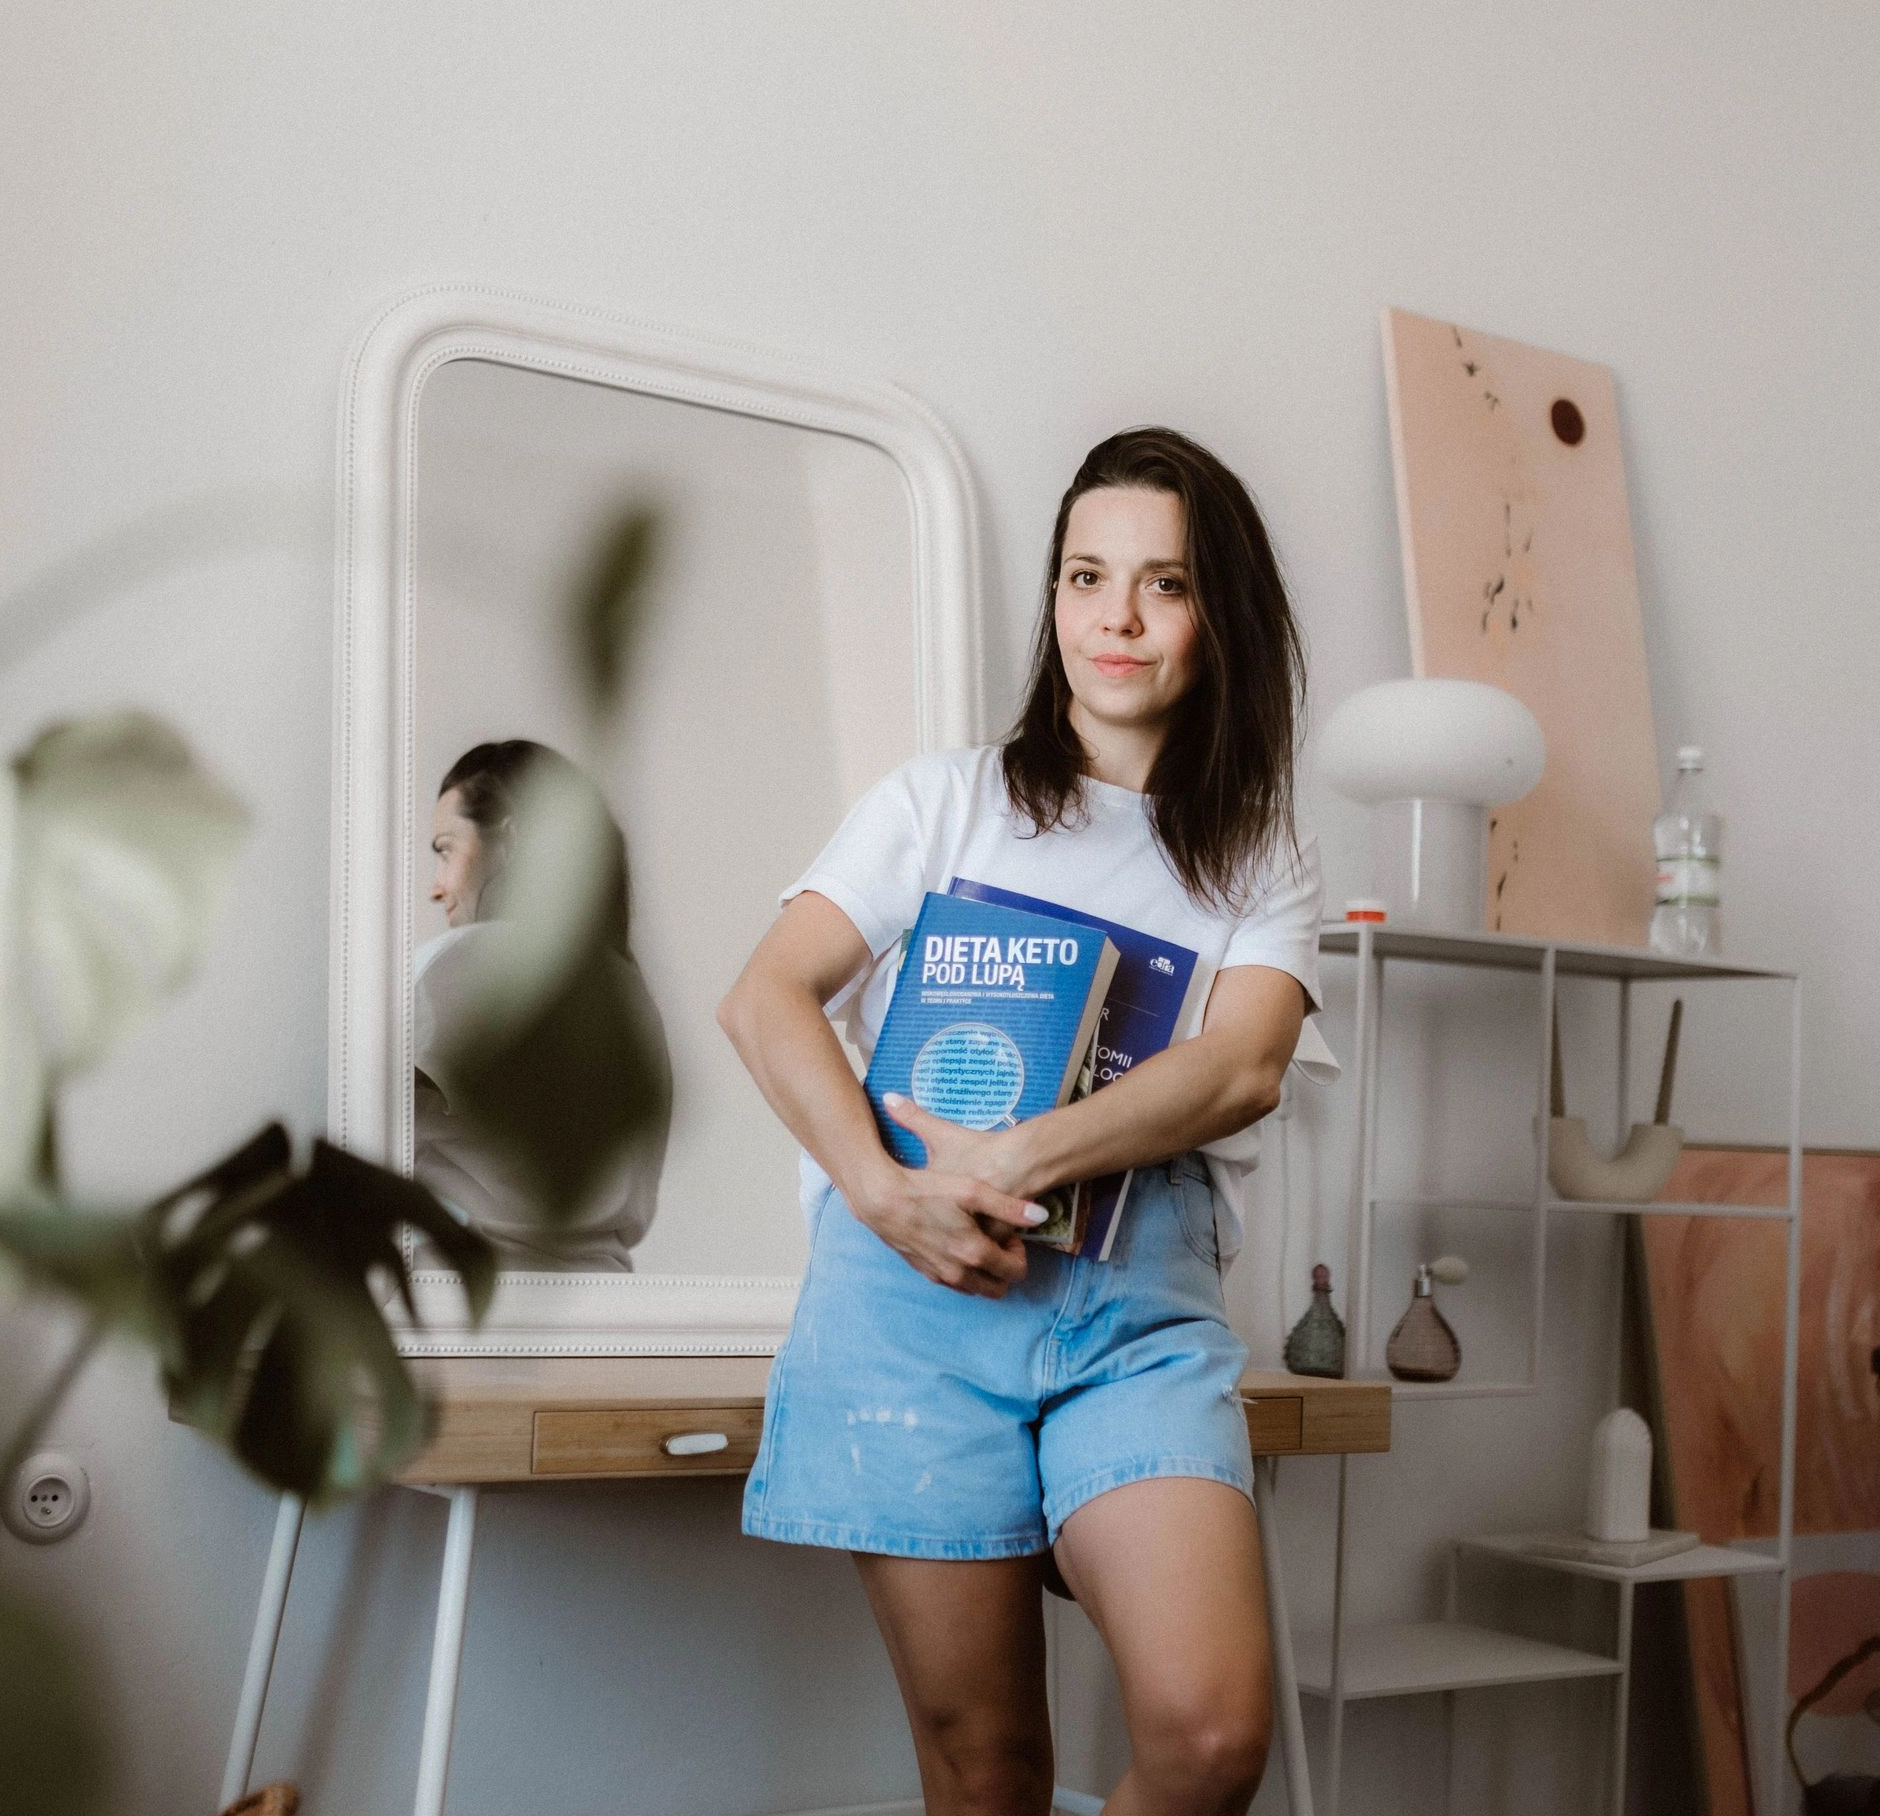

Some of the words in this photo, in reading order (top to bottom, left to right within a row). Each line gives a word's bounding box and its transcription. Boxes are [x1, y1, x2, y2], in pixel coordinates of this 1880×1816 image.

[924, 936, 1001, 963] DIETA
[1007, 937, 1079, 966] KETO
[922, 963, 966, 985] POD
[971, 964, 1025, 991] LUPĄ
